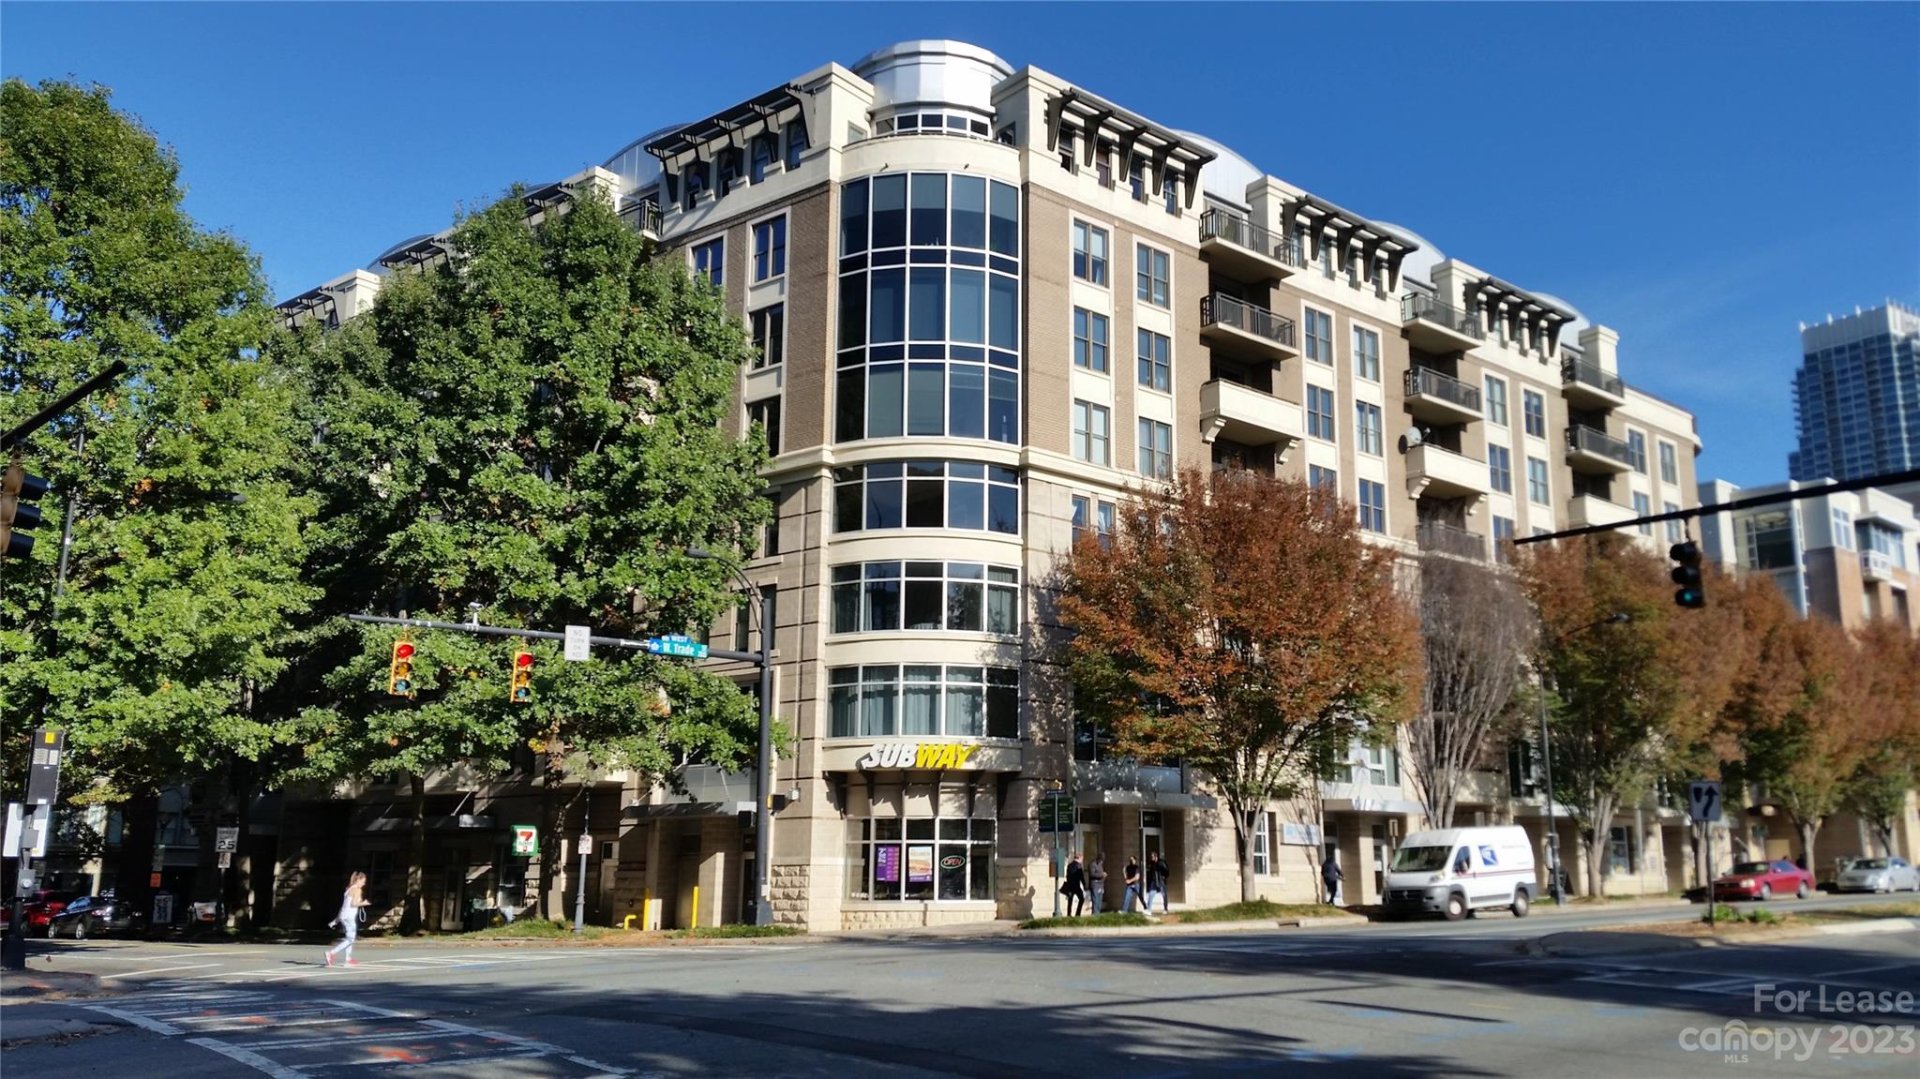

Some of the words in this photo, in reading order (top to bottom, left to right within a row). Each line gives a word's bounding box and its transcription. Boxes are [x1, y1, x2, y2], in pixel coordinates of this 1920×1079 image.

[674, 642, 695, 656] Trade
[859, 743, 980, 770] SUBWAY
[519, 831, 533, 841] 7
[218, 840, 236, 850] 25
[943, 857, 962, 866] OPEN
